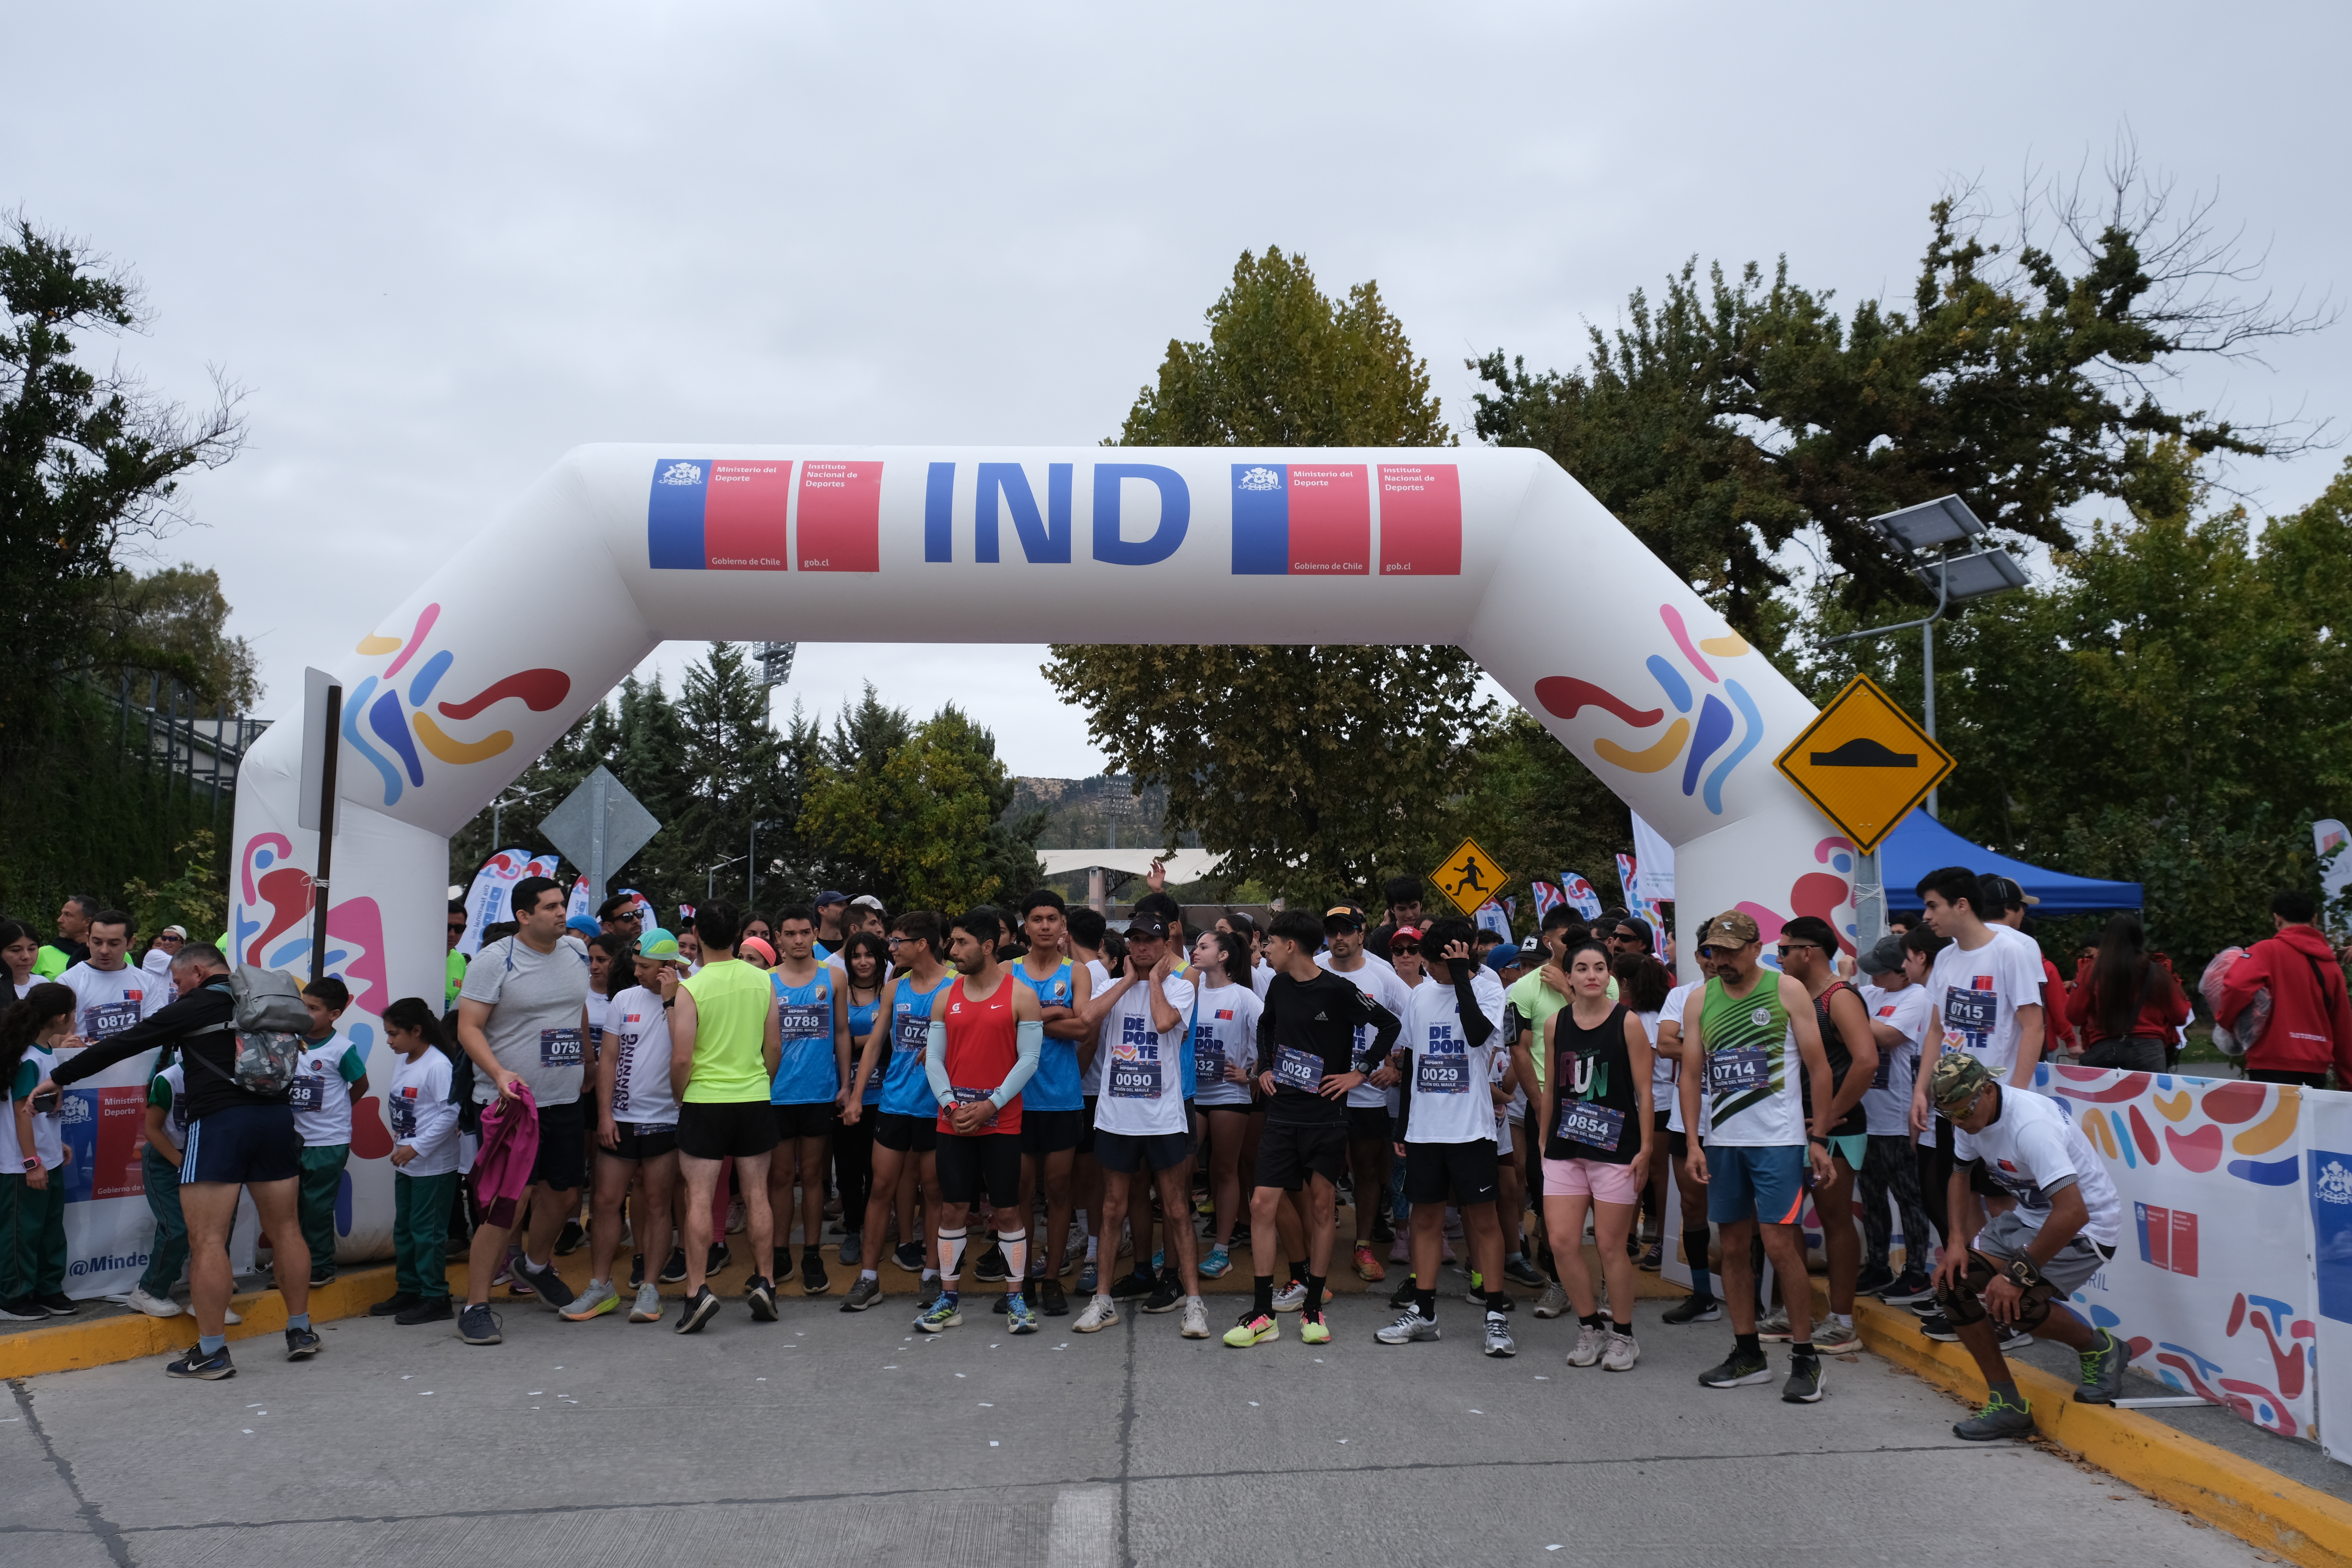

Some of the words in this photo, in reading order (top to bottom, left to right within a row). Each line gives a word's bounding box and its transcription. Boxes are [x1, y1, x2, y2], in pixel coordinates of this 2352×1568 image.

[925, 462, 1190, 566] IND
[804, 558, 829, 567] gob.cl
[1386, 563, 1411, 572] gob.cl
[1950, 1001, 1983, 1019] 0715
[98, 1013, 137, 1029] 0872
[784, 1016, 819, 1027] 0788
[1123, 1017, 1145, 1031] DE
[905, 1026, 928, 1039] 074
[1122, 1031, 1158, 1046] POR
[1195, 1026, 1213, 1038] DE
[1430, 1026, 1451, 1040] DE
[1430, 1040, 1465, 1054] POR
[1966, 1032, 1988, 1048] TE
[551, 1041, 580, 1054] 0752
[1138, 1046, 1158, 1060] TE
[619, 1034, 638, 1111] RUNNING
[1282, 1060, 1312, 1079] 0028
[1422, 1068, 1458, 1081] 0029
[1559, 1051, 1608, 1101] RUN
[1713, 1062, 1755, 1080] 0714
[1116, 1073, 1152, 1086] 0090
[104, 1097, 144, 1106] Ministerio
[104, 1108, 135, 1117] Deporte
[1568, 1114, 1609, 1135] 0854
[1588, 1133, 1605, 1141] MAULE
[98, 1186, 130, 1194] Gobierno
[69, 1252, 152, 1277] @Minde
